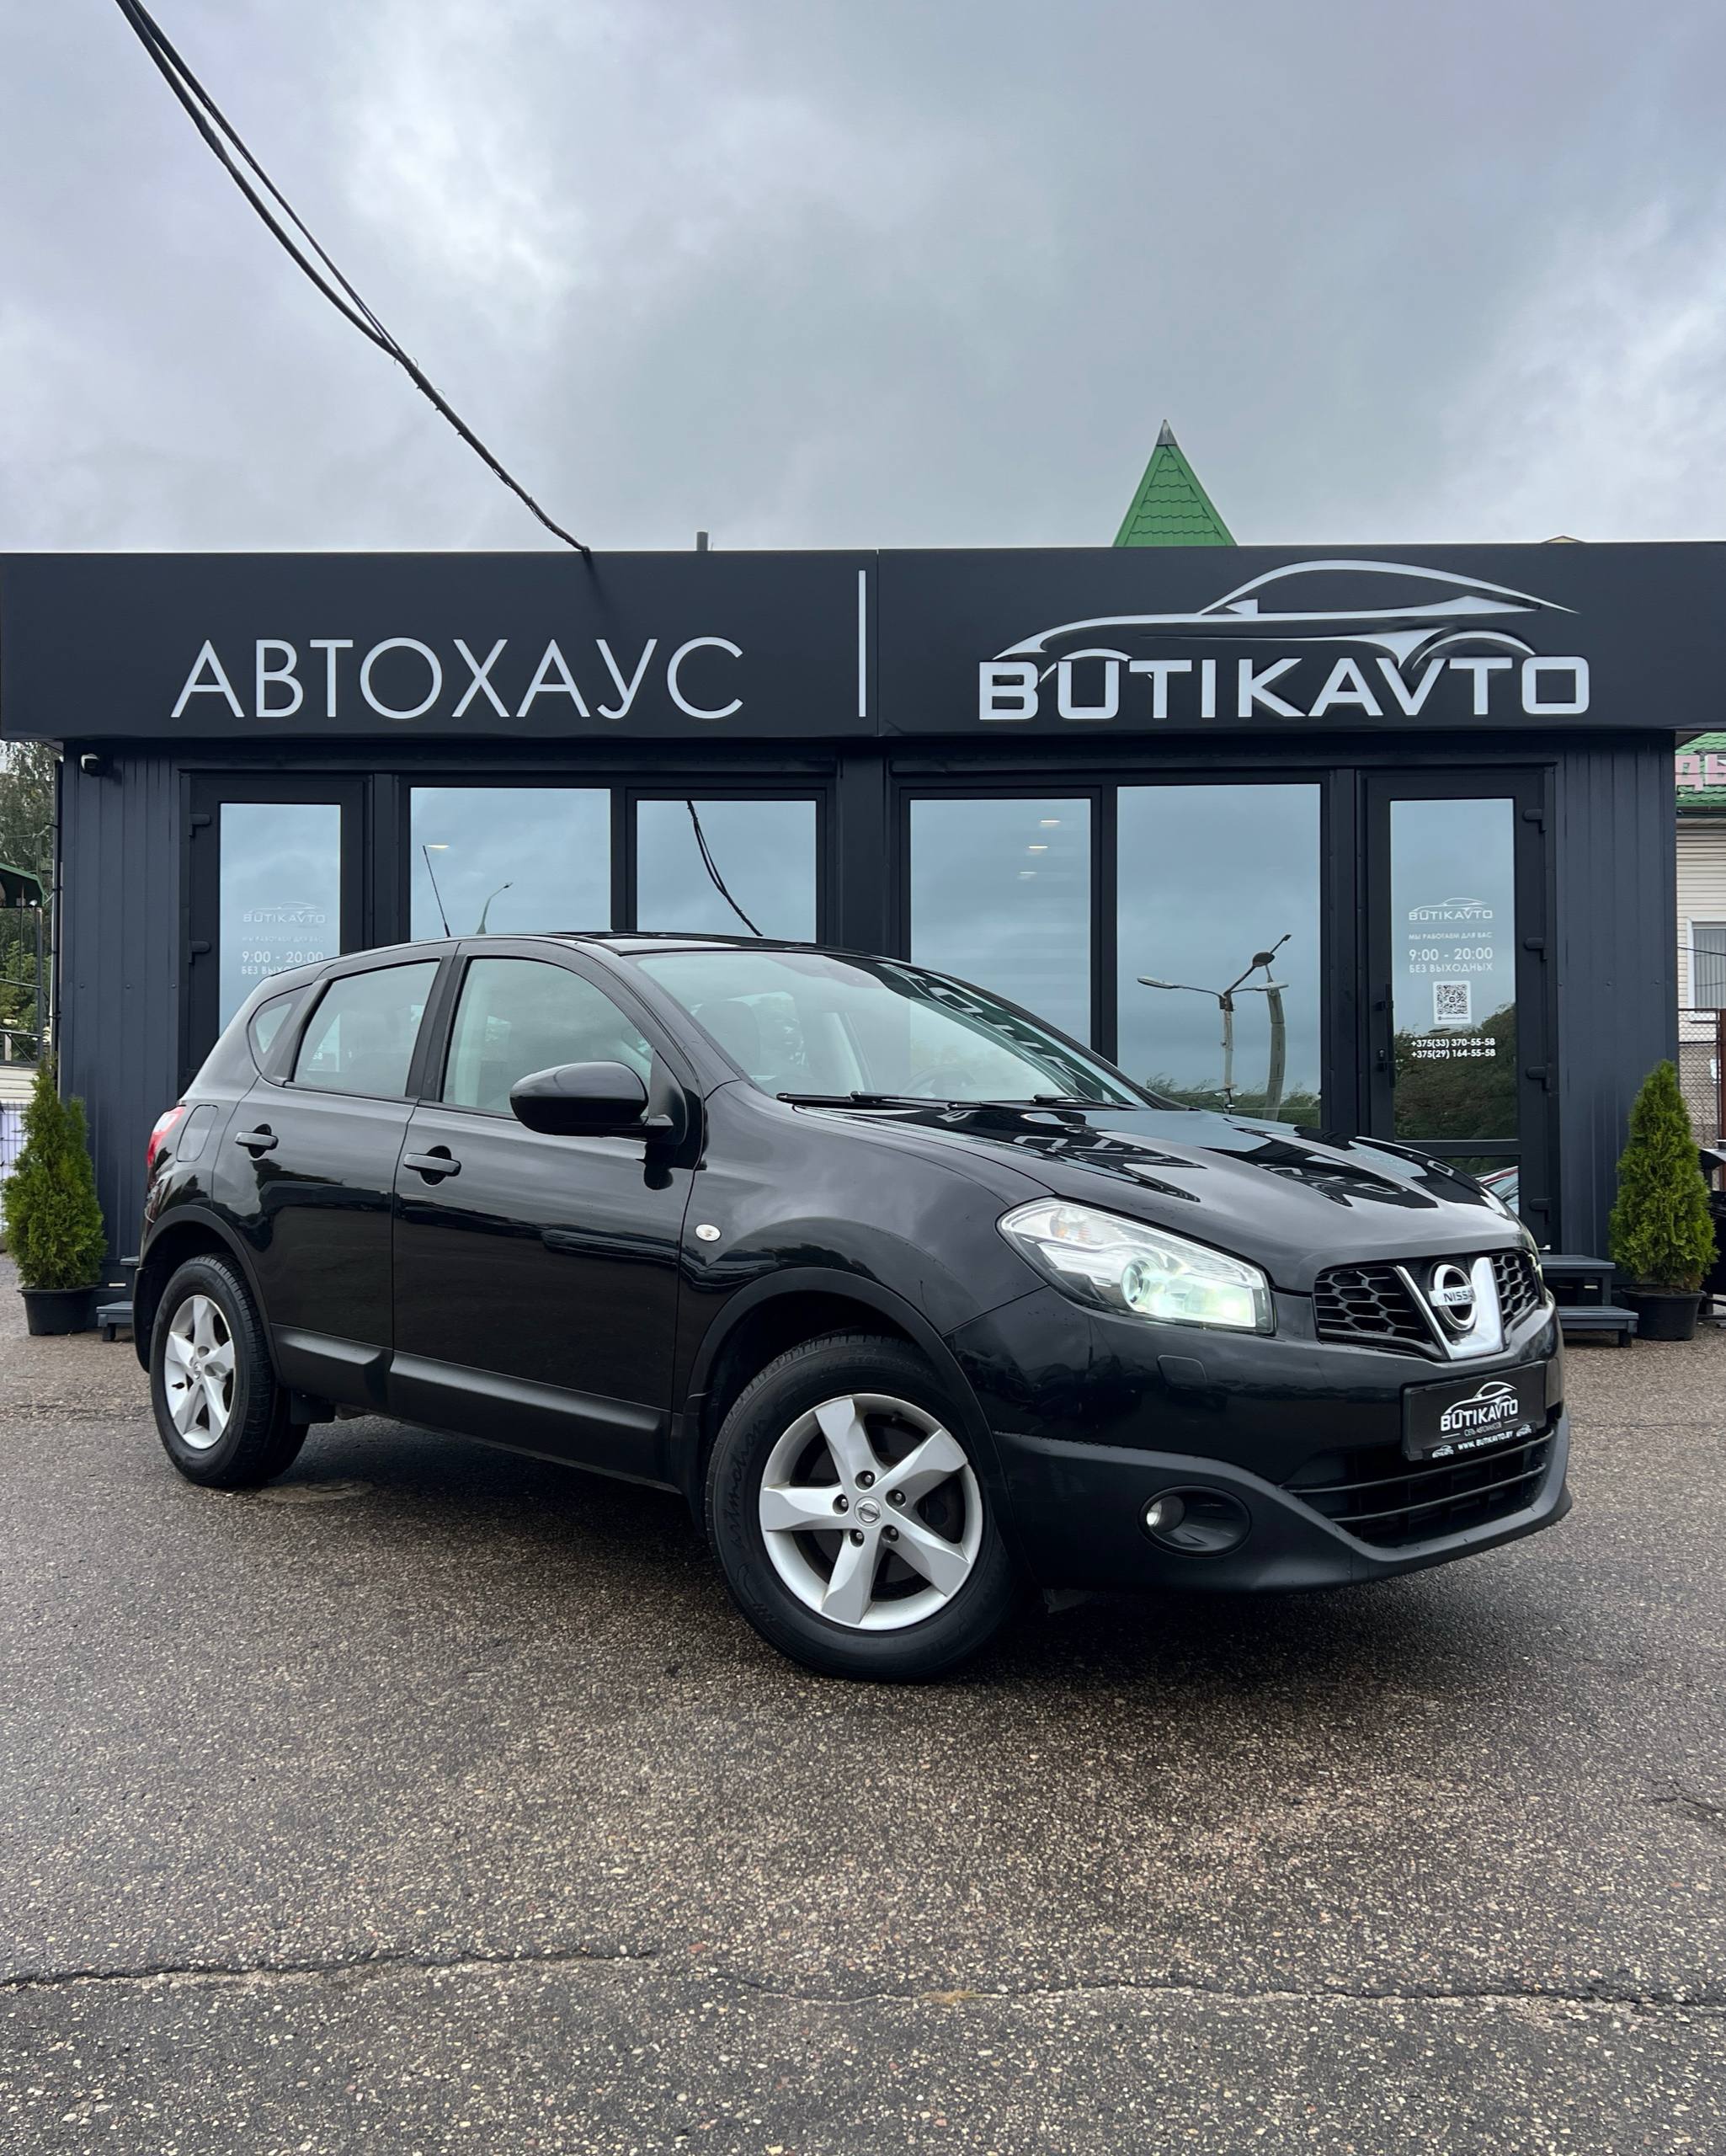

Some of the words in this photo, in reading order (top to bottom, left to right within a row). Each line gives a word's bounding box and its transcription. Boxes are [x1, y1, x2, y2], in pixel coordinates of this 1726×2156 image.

[171, 637, 743, 719] АВТОХАУС
[979, 655, 1590, 720] BUTIKAVTO
[242, 913, 326, 923] BUTIKAVTO
[1409, 910, 1494, 921] BUTIKAVTO
[242, 951, 271, 963] 9:00
[285, 951, 324, 963] 20:00
[1409, 948, 1439, 961] 9:00
[1454, 947, 1493, 960] 20:00
[242, 965, 258, 974] БЕЗ
[1409, 963, 1426, 974] БЕЗ
[1430, 963, 1493, 973] ВЫХОДНЫХ
[1411, 1038, 1449, 1049] +375(33)
[1451, 1038, 1495, 1046] 370-55-58
[1411, 1049, 1450, 1059] +375(29)
[1452, 1049, 1496, 1057] 164-55-58
[1441, 1399, 1518, 1431] BUTIKAVTO
